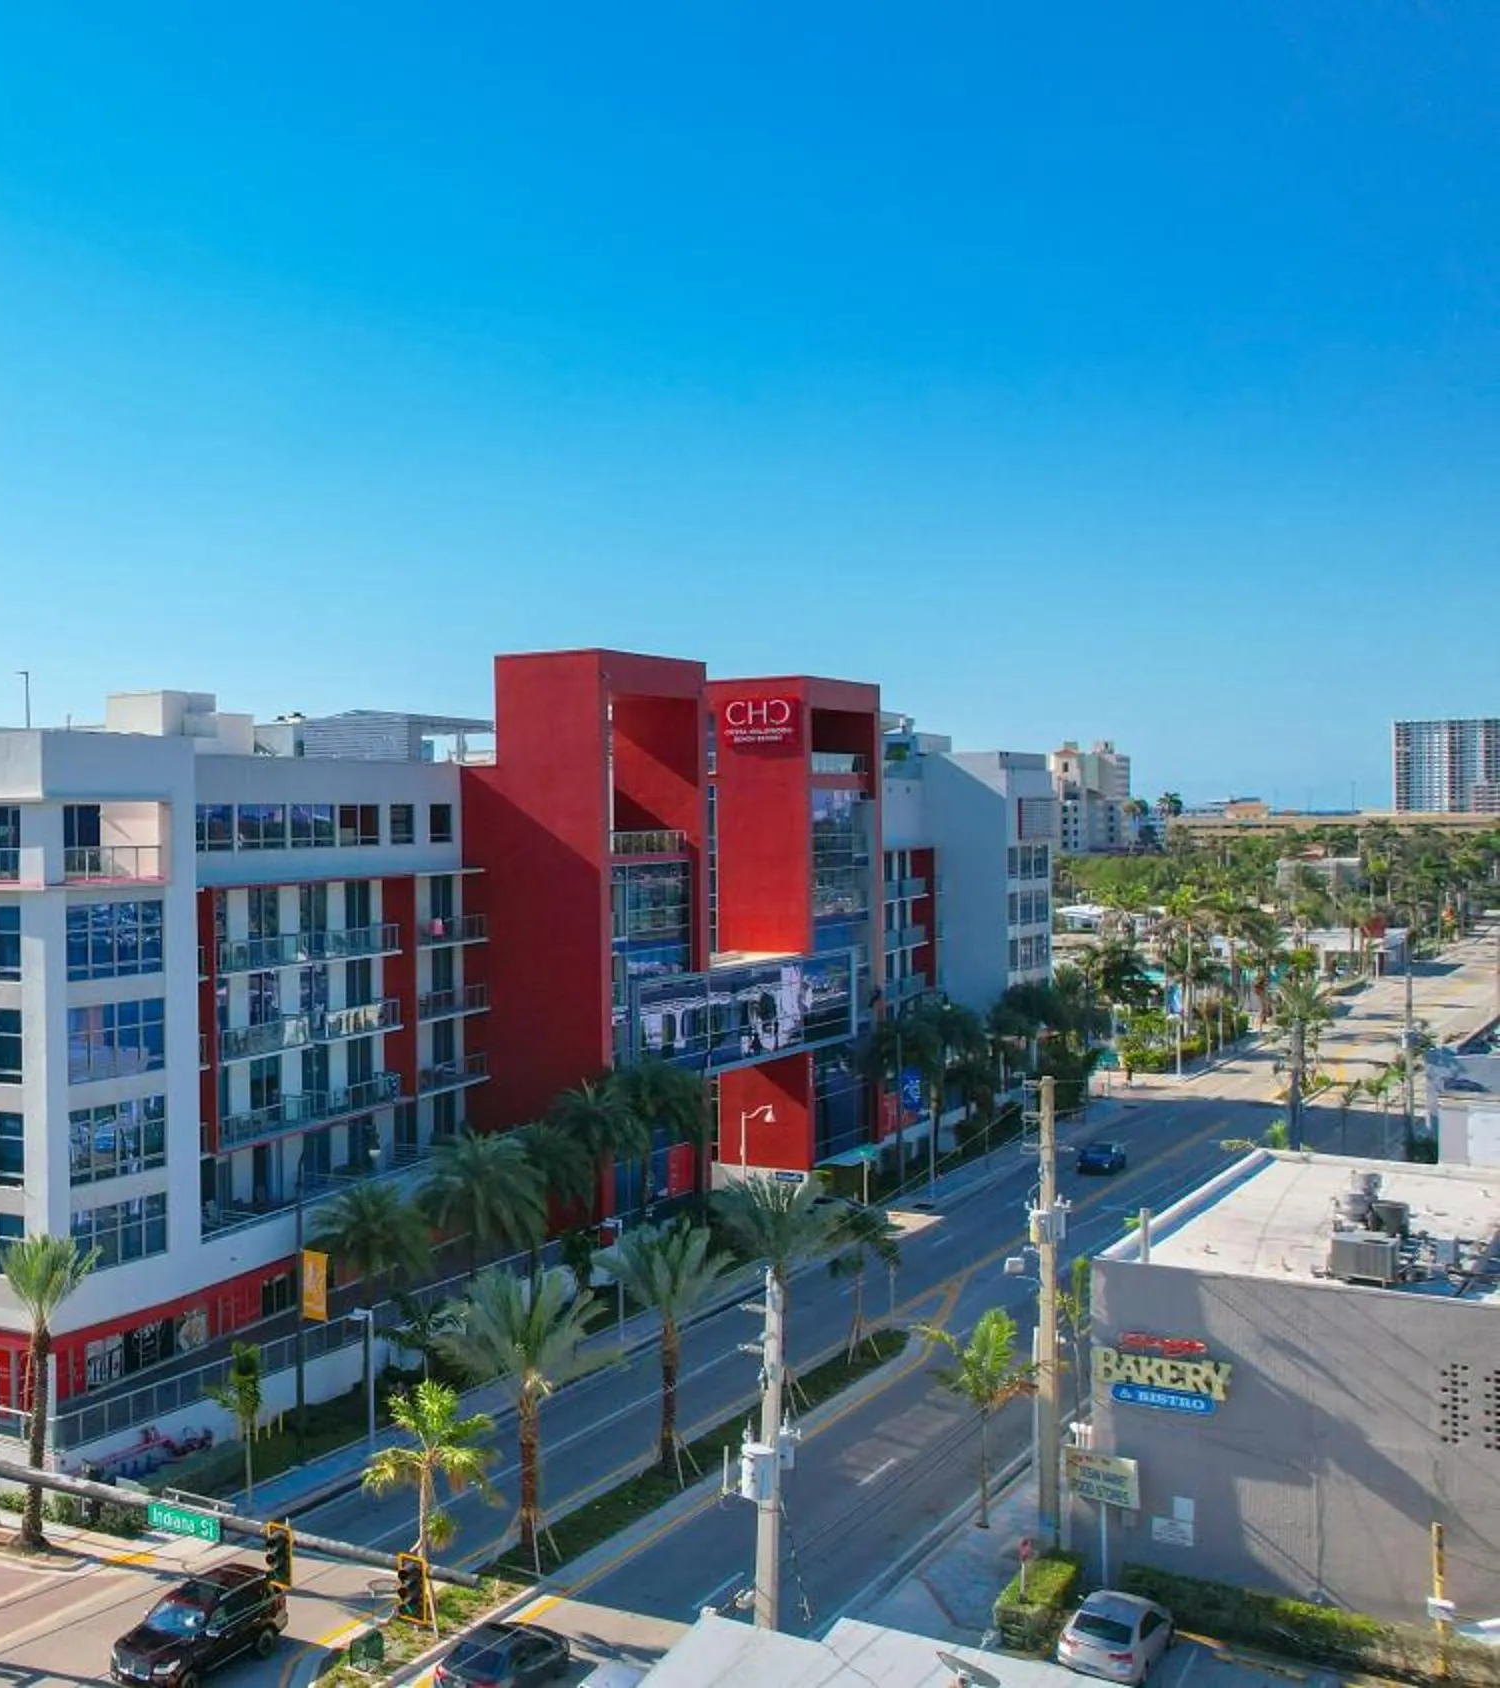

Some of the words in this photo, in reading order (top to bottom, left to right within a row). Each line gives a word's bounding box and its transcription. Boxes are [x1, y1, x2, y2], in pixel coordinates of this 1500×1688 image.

[1090, 1345, 1232, 1401] BAKERY
[1119, 1387, 1132, 1400] &
[1139, 1391, 1206, 1410] BISTRO
[152, 1507, 196, 1533] Indiana
[200, 1518, 215, 1538] St
